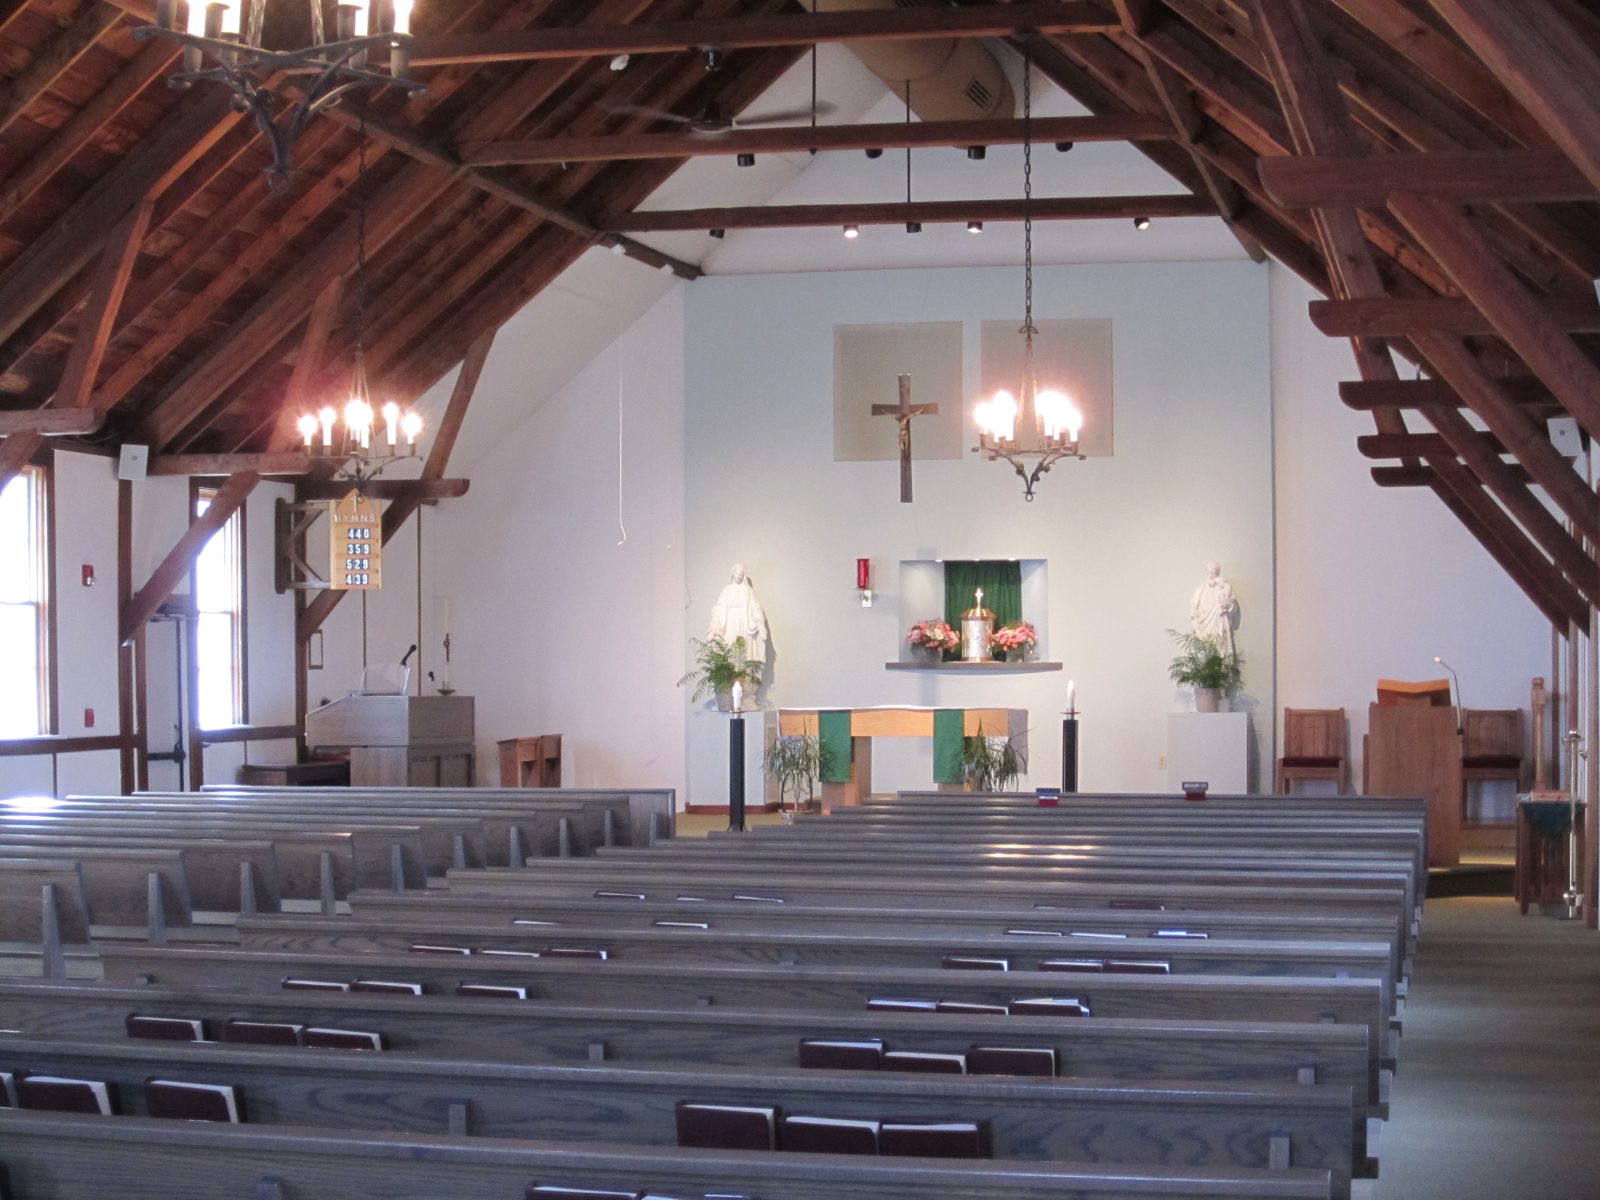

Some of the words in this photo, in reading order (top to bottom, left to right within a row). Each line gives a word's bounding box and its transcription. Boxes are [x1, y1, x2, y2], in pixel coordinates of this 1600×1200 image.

[334, 514, 375, 523] HYMNS
[348, 528, 370, 539] 440
[347, 544, 370, 554] 359
[346, 559, 369, 570] 529
[346, 574, 368, 585] 439
